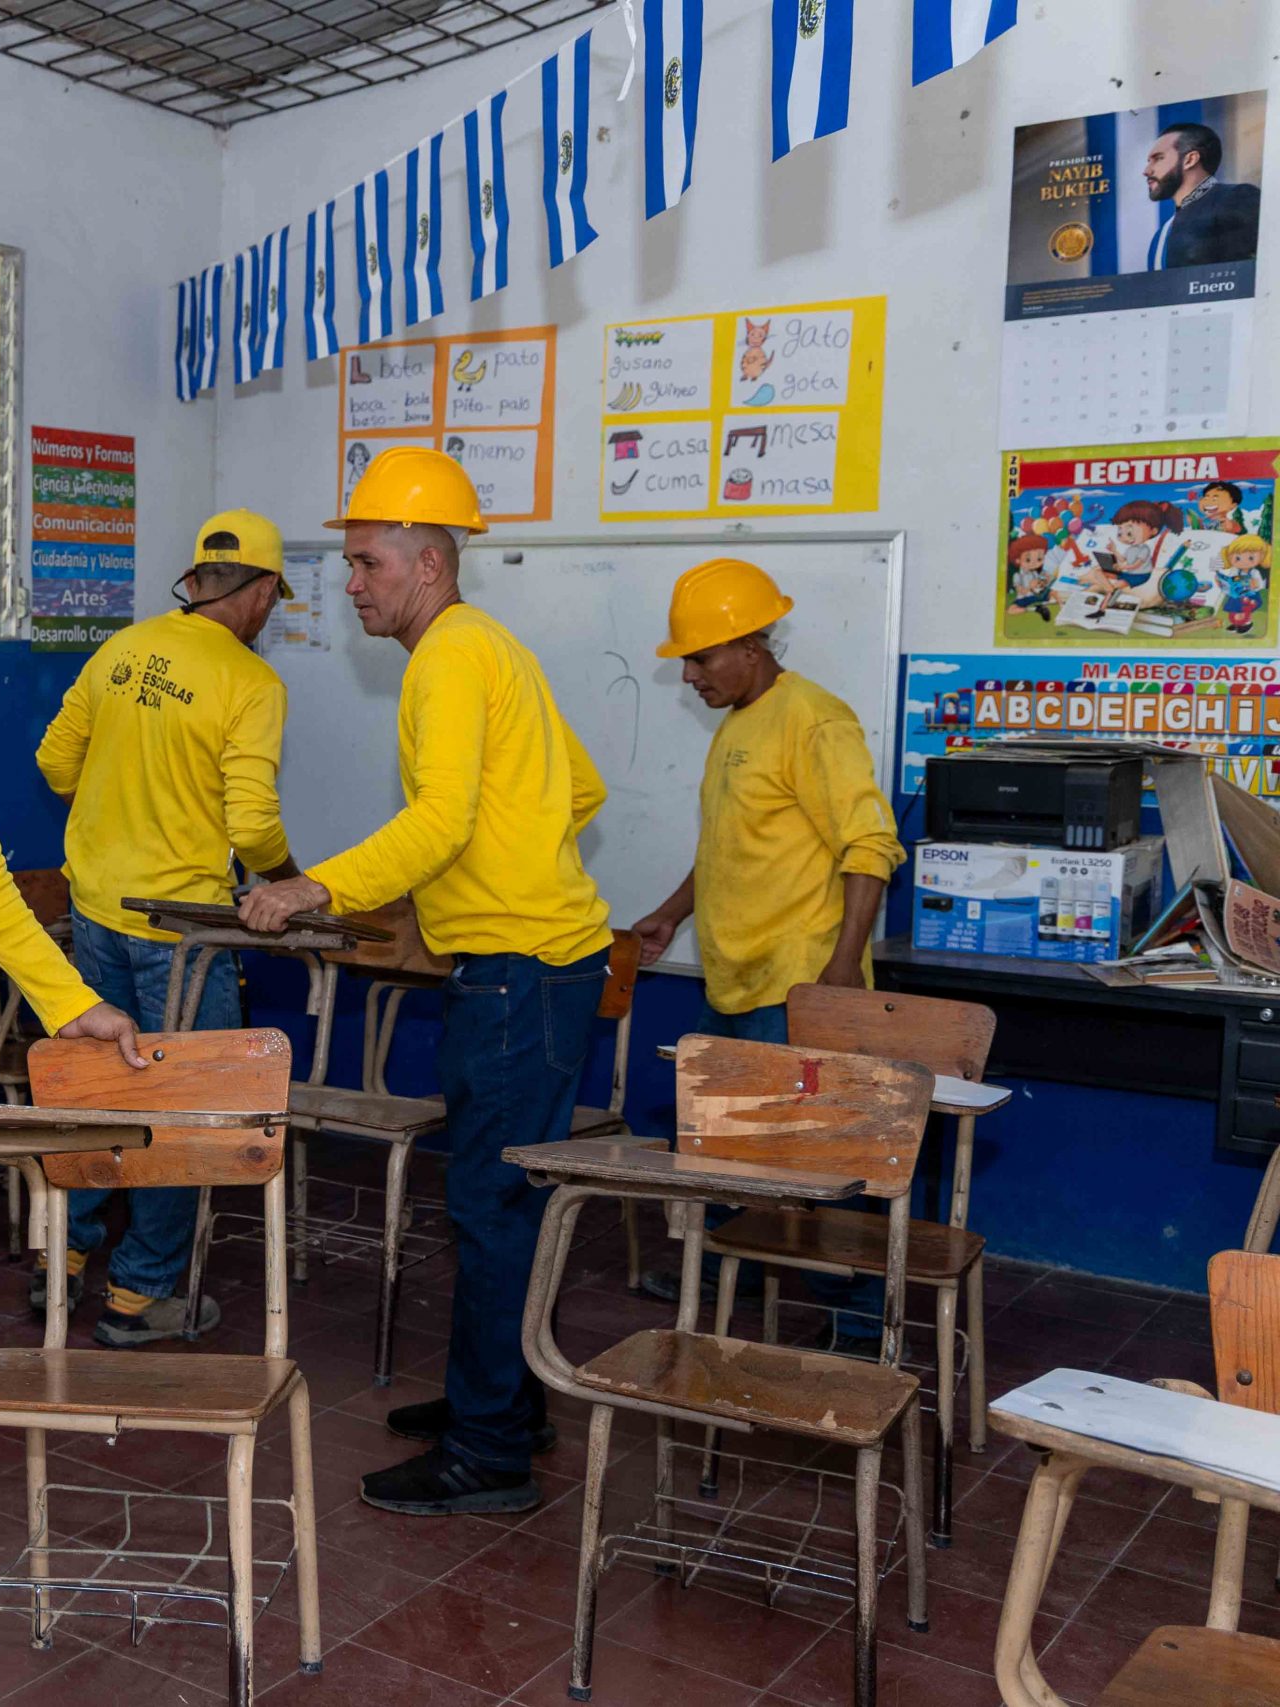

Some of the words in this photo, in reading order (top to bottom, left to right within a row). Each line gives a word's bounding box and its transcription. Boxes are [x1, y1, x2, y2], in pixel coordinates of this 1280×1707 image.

[1049, 164, 1102, 183] NAYIB
[1040, 179, 1110, 200] BUKELE
[1189, 281, 1234, 294] Enero
[781, 319, 850, 358] gato
[379, 356, 425, 379] bota
[493, 351, 539, 378] pato
[609, 355, 672, 378] gusano
[643, 380, 698, 406] guineo
[781, 370, 839, 400] gota
[350, 397, 386, 413] boca
[33, 438, 84, 459] Números
[85, 447, 92, 464] y
[95, 445, 134, 464] Formas
[648, 436, 709, 460] casa
[1009, 456, 1017, 497] ZONA
[1074, 456, 1219, 485] LECTURA
[34, 474, 69, 492] Ciencia
[645, 472, 704, 491] cuma
[760, 475, 831, 496] masa
[33, 513, 134, 534] Comunicación
[91, 557, 96, 572] y
[99, 553, 134, 569] Valores
[61, 590, 108, 606] Artes
[32, 626, 87, 642] Desarrollo
[147, 654, 171, 675] DOS
[1083, 664, 1108, 678] MI
[1115, 664, 1276, 681] ABECEDARIO
[143, 672, 194, 705] ESCUELAS
[1045, 682, 1055, 691] c
[976, 695, 1000, 722] A
[1008, 696, 1030, 723] B
[1037, 696, 1060, 724] C
[1069, 697, 1093, 726] D
[1100, 697, 1124, 727] E
[1134, 698, 1156, 729] F
[1165, 698, 1190, 729] G
[1198, 700, 1224, 730] H
[1231, 760, 1258, 791] V
[923, 849, 968, 861] EPSON
[1082, 858, 1111, 867] L3250
